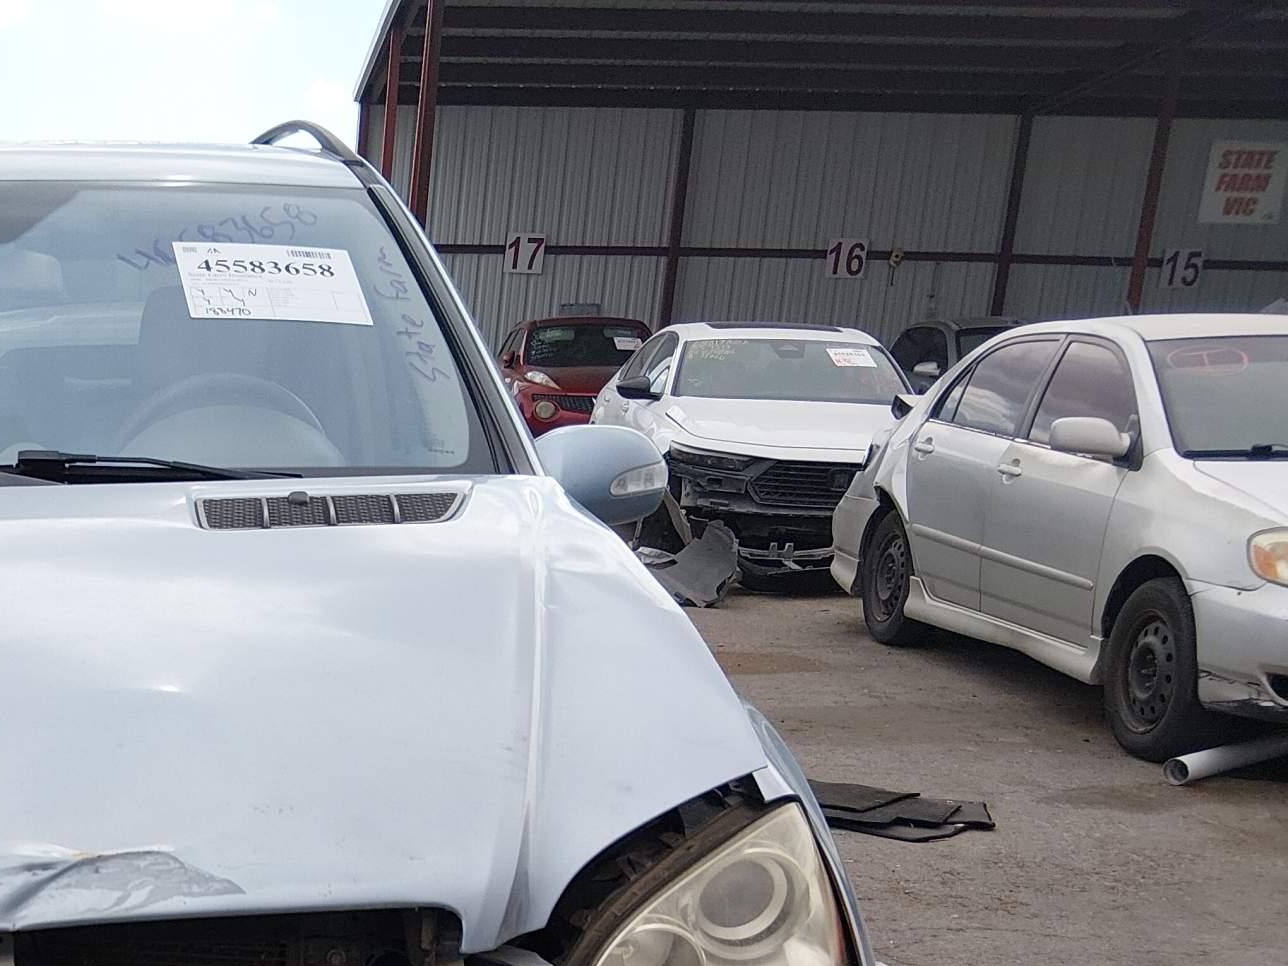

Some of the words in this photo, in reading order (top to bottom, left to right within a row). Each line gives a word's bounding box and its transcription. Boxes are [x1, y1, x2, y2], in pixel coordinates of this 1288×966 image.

[1218, 149, 1280, 170] STATE
[1215, 173, 1272, 193] FARM
[1222, 197, 1259, 217] VIC
[508, 236, 545, 270] 17
[828, 241, 866, 277] 16
[197, 258, 335, 278] 45583658
[1165, 250, 1203, 287] 15
